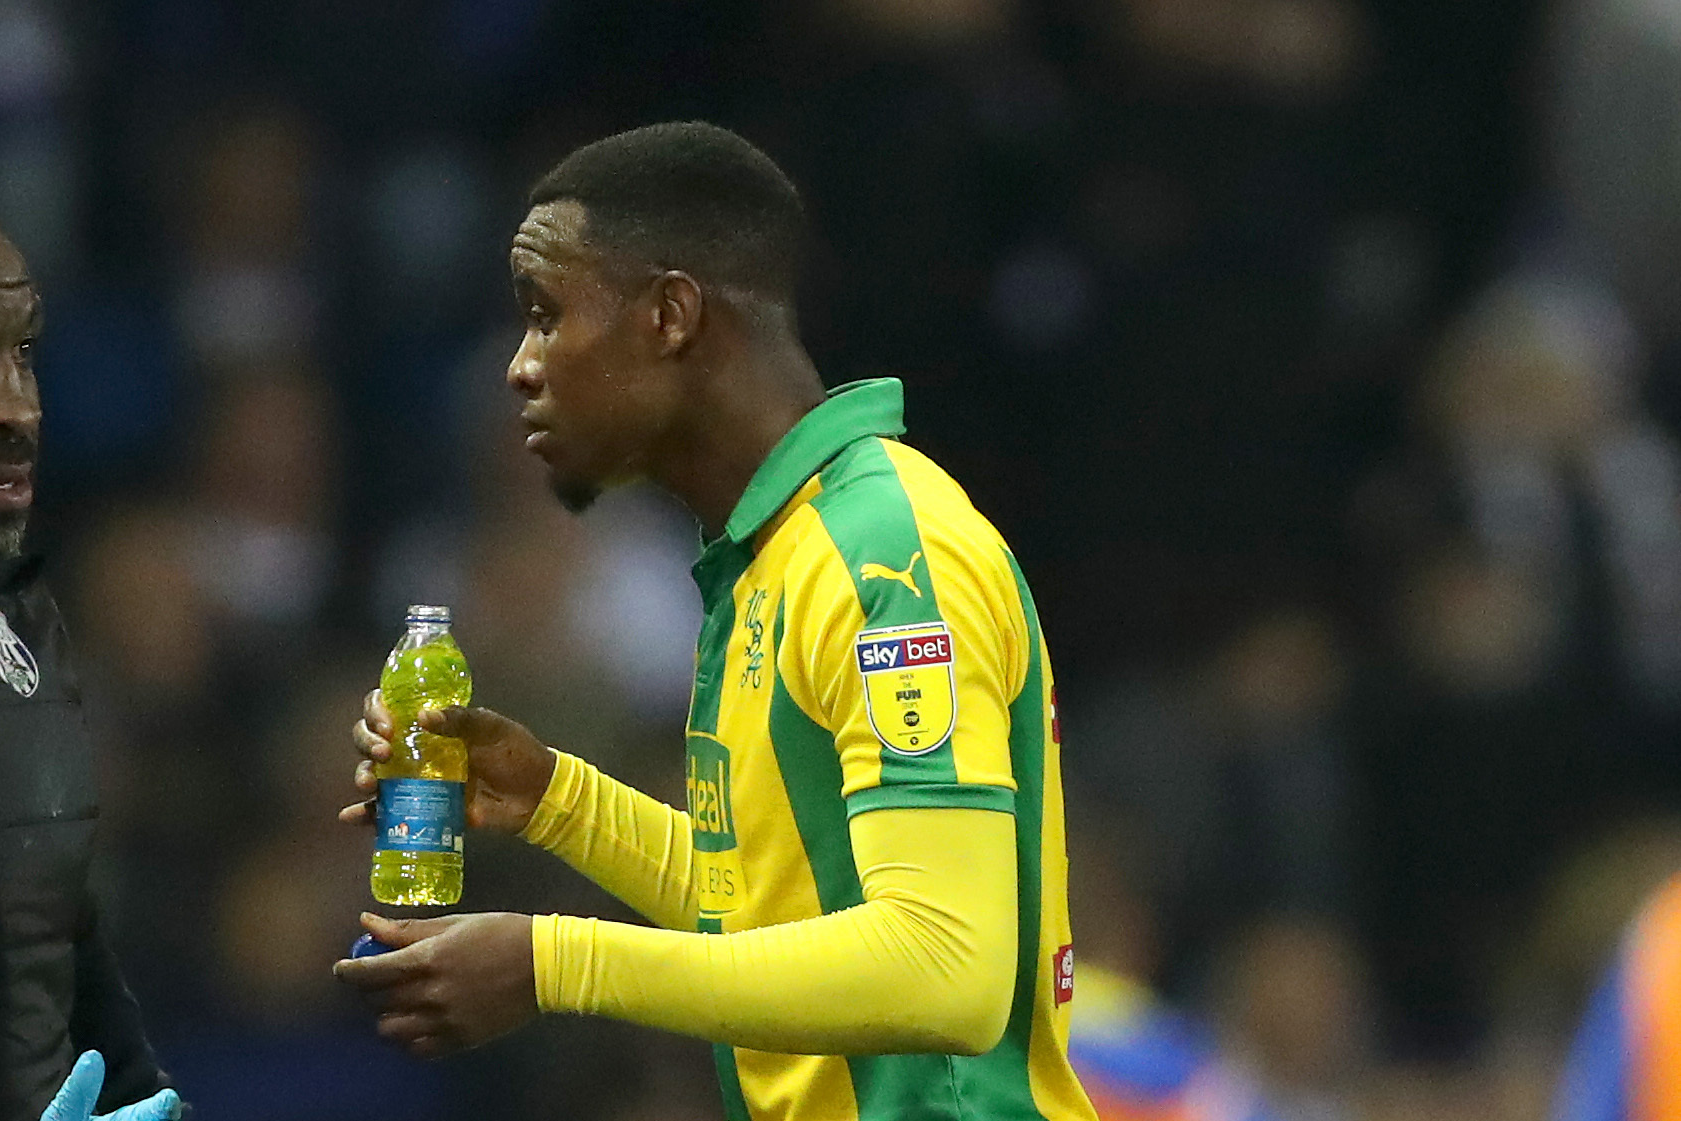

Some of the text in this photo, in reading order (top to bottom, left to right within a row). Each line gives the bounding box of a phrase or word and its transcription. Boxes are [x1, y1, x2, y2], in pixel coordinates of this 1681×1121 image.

[862, 638, 948, 667] sky bet
[896, 689, 922, 701] FUN
